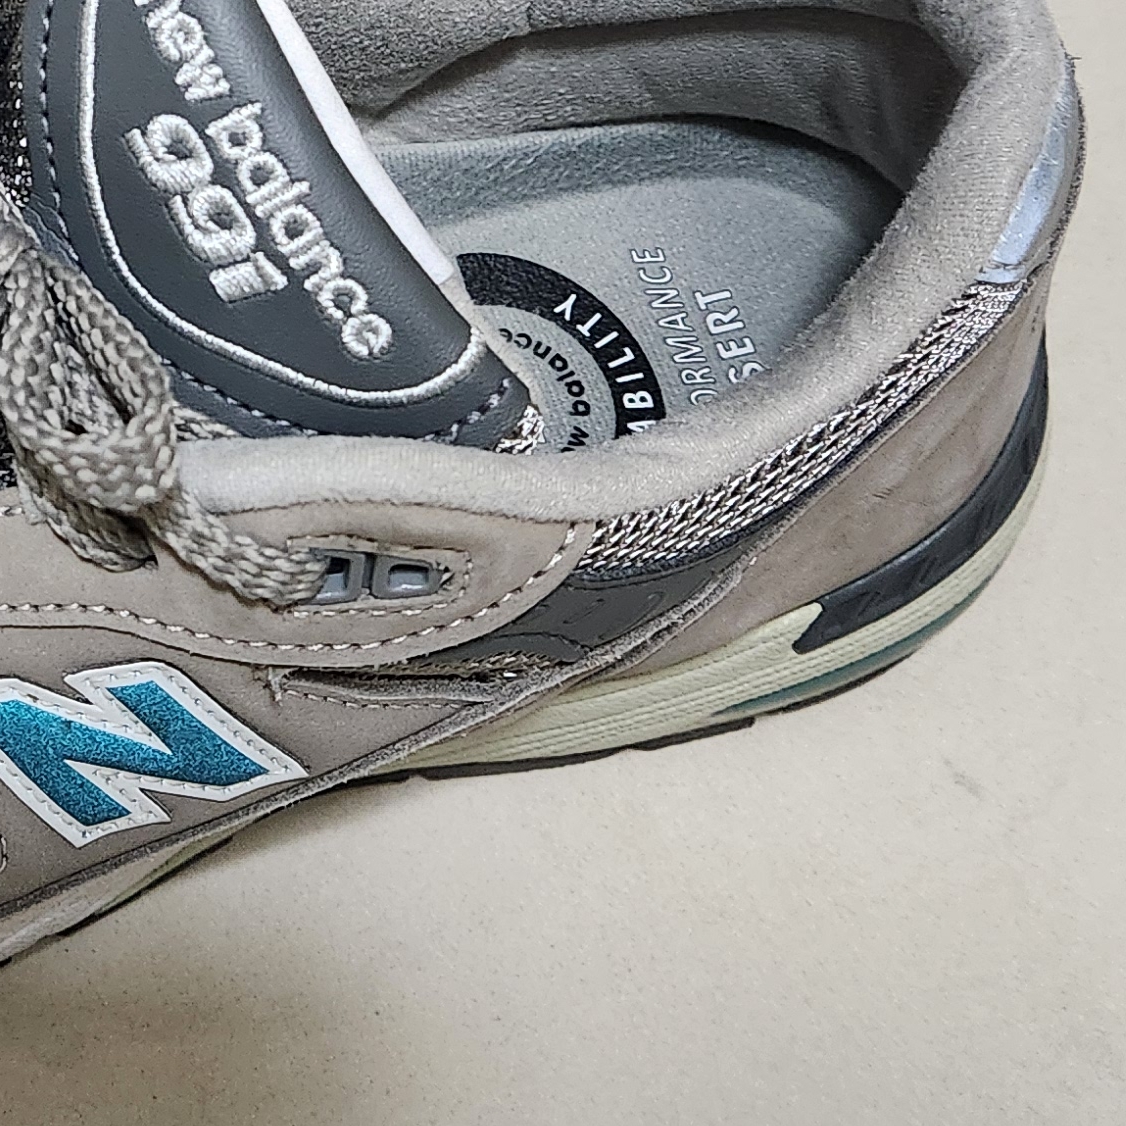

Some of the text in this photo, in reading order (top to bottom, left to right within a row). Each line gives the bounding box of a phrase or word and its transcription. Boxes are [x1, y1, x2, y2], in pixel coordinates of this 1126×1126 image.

[124, 113, 289, 302] 991
[204, 101, 393, 357] balance
[498, 328, 591, 417] balance
